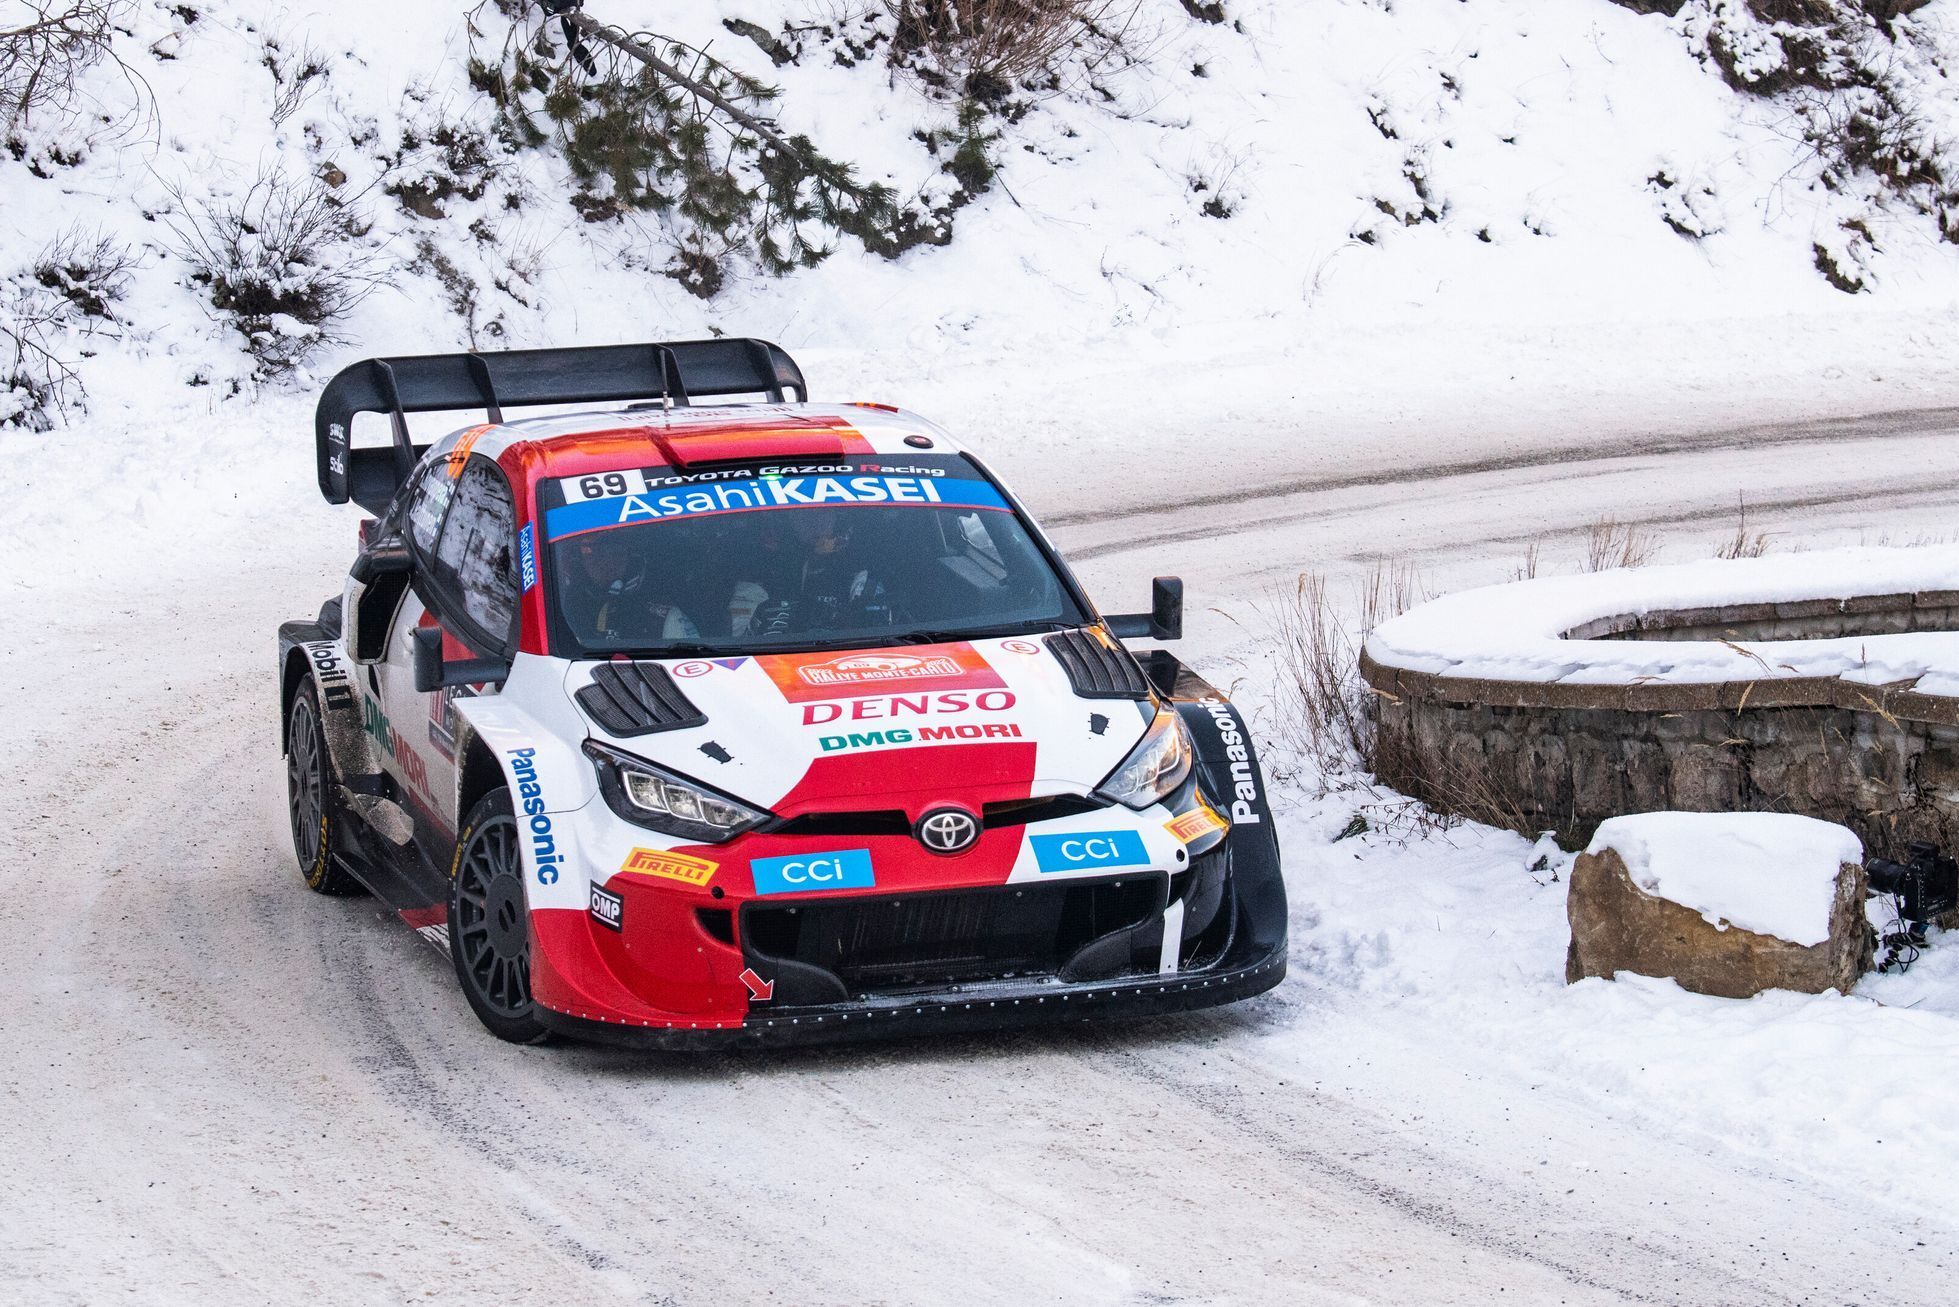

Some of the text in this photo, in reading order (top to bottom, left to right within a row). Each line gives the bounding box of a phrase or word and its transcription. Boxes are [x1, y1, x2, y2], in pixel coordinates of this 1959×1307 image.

[579, 473, 628, 498] 69
[645, 464, 946, 487] TOYOTA GAZOO Racing
[307, 640, 348, 682] Mobil
[802, 691, 1016, 726] DENSO
[818, 724, 1023, 751] DMG MORI
[1197, 697, 1260, 825] Panasonic
[507, 747, 565, 885] Panasonic
[629, 852, 709, 880] PIRELLI
[592, 893, 619, 920] OMP
